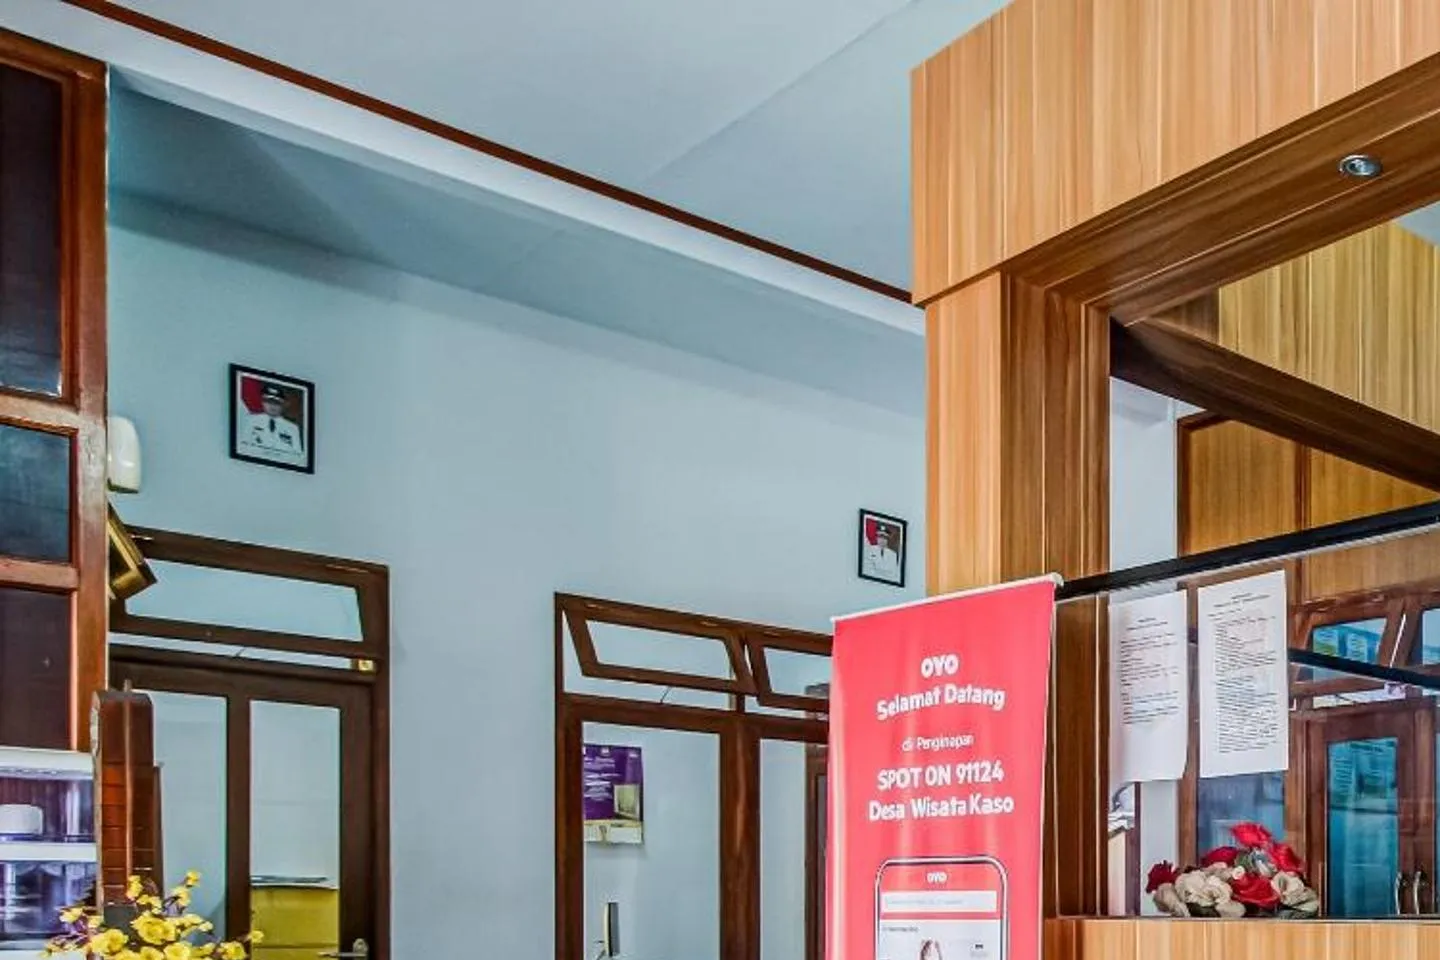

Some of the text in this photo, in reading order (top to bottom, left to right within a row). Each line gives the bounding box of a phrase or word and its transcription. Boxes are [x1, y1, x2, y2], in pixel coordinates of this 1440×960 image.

[921, 653, 959, 678] OYO
[876, 683, 1006, 720] Selamat Datang
[917, 735, 974, 751] Penginapan
[877, 760, 1004, 790] SPOT ON 91124
[868, 793, 1015, 821] Desa Wisata Kaso
